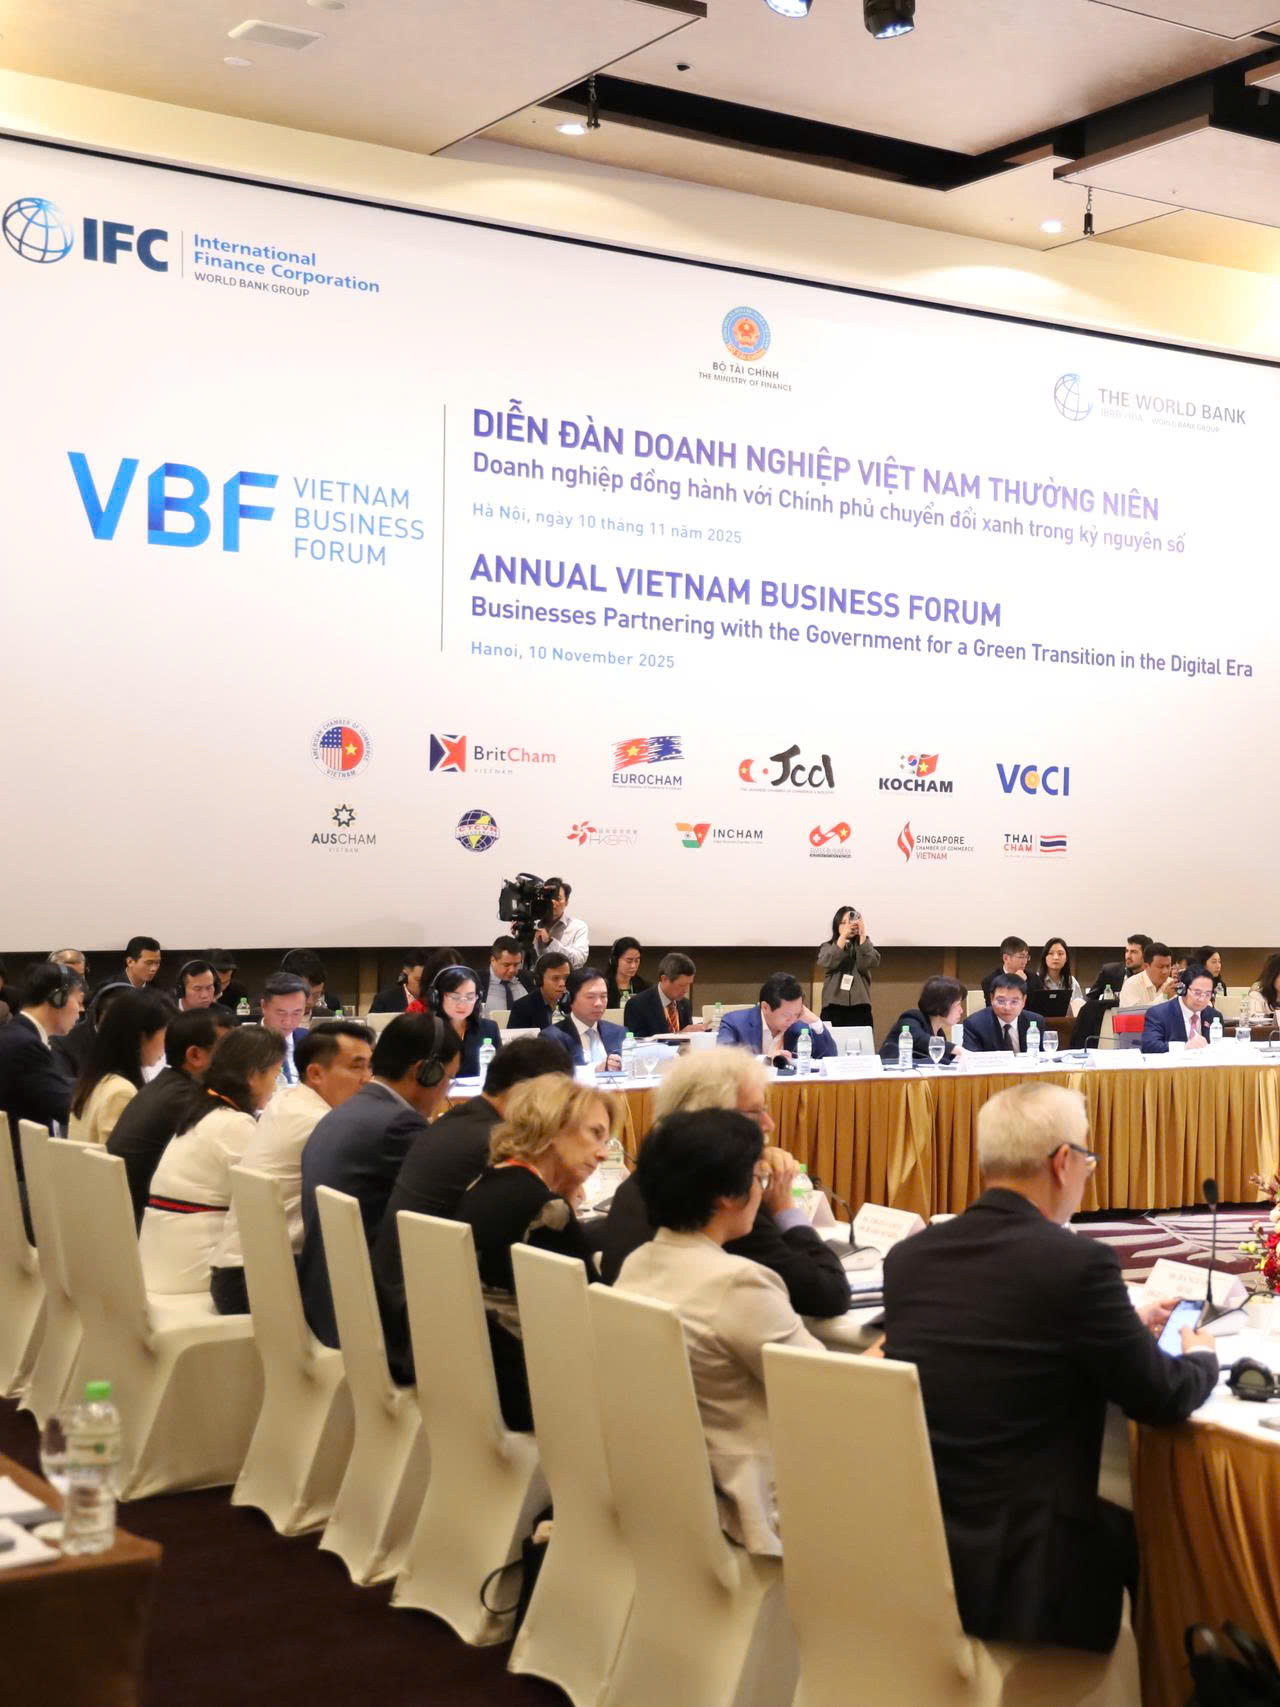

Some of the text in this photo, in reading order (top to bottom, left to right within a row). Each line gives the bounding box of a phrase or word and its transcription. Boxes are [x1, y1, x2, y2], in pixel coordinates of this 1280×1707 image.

[83, 217, 168, 272] IFC
[194, 234, 316, 266] International
[194, 251, 380, 293] Finance Corporation
[194, 272, 310, 298] WORLD BANK GROUP
[698, 371, 711, 380] THE
[714, 374, 746, 385] MINISTRY
[761, 381, 792, 392] FINANCE
[1098, 388, 1246, 424] THE WORLD BANK
[474, 398, 1159, 521] DIỄN ĐÀN DOANH NGHIỆP VIỆT NAM THƯỜNG NIÊN
[67, 451, 279, 552] VBF
[294, 477, 409, 509] VIETNAM
[474, 451, 1187, 553] Doanh nghiệp đồng hành với Chính phủ chuyển đổi xanh trong kỷ nguyên số
[295, 507, 424, 540] BUSINESS
[473, 502, 742, 544] Hà Nội, ngày 10 tháng 11 năm 2025
[295, 537, 386, 566] FORUM
[470, 553, 1000, 627] ANNUAL VIETNAM BUSINESS FORUM
[471, 596, 1253, 677] Businesses Partnering with the Government for a Green Transition in the Digital Era
[471, 641, 675, 668] Hanoi, 10 November 2025
[474, 745, 556, 763] BritCham
[326, 768, 356, 778] VIETNAM
[612, 773, 682, 786] EUROCHAM
[879, 777, 953, 793] KOCHAM
[996, 763, 1070, 796] VCCI
[312, 832, 376, 845] AUSCHAM
[713, 829, 763, 840] INCHAM
[916, 835, 965, 845] SINGAPORE
[1003, 843, 1032, 852] CHAM
[1004, 833, 1032, 843] THAI
[916, 851, 947, 860] VIETNAM
